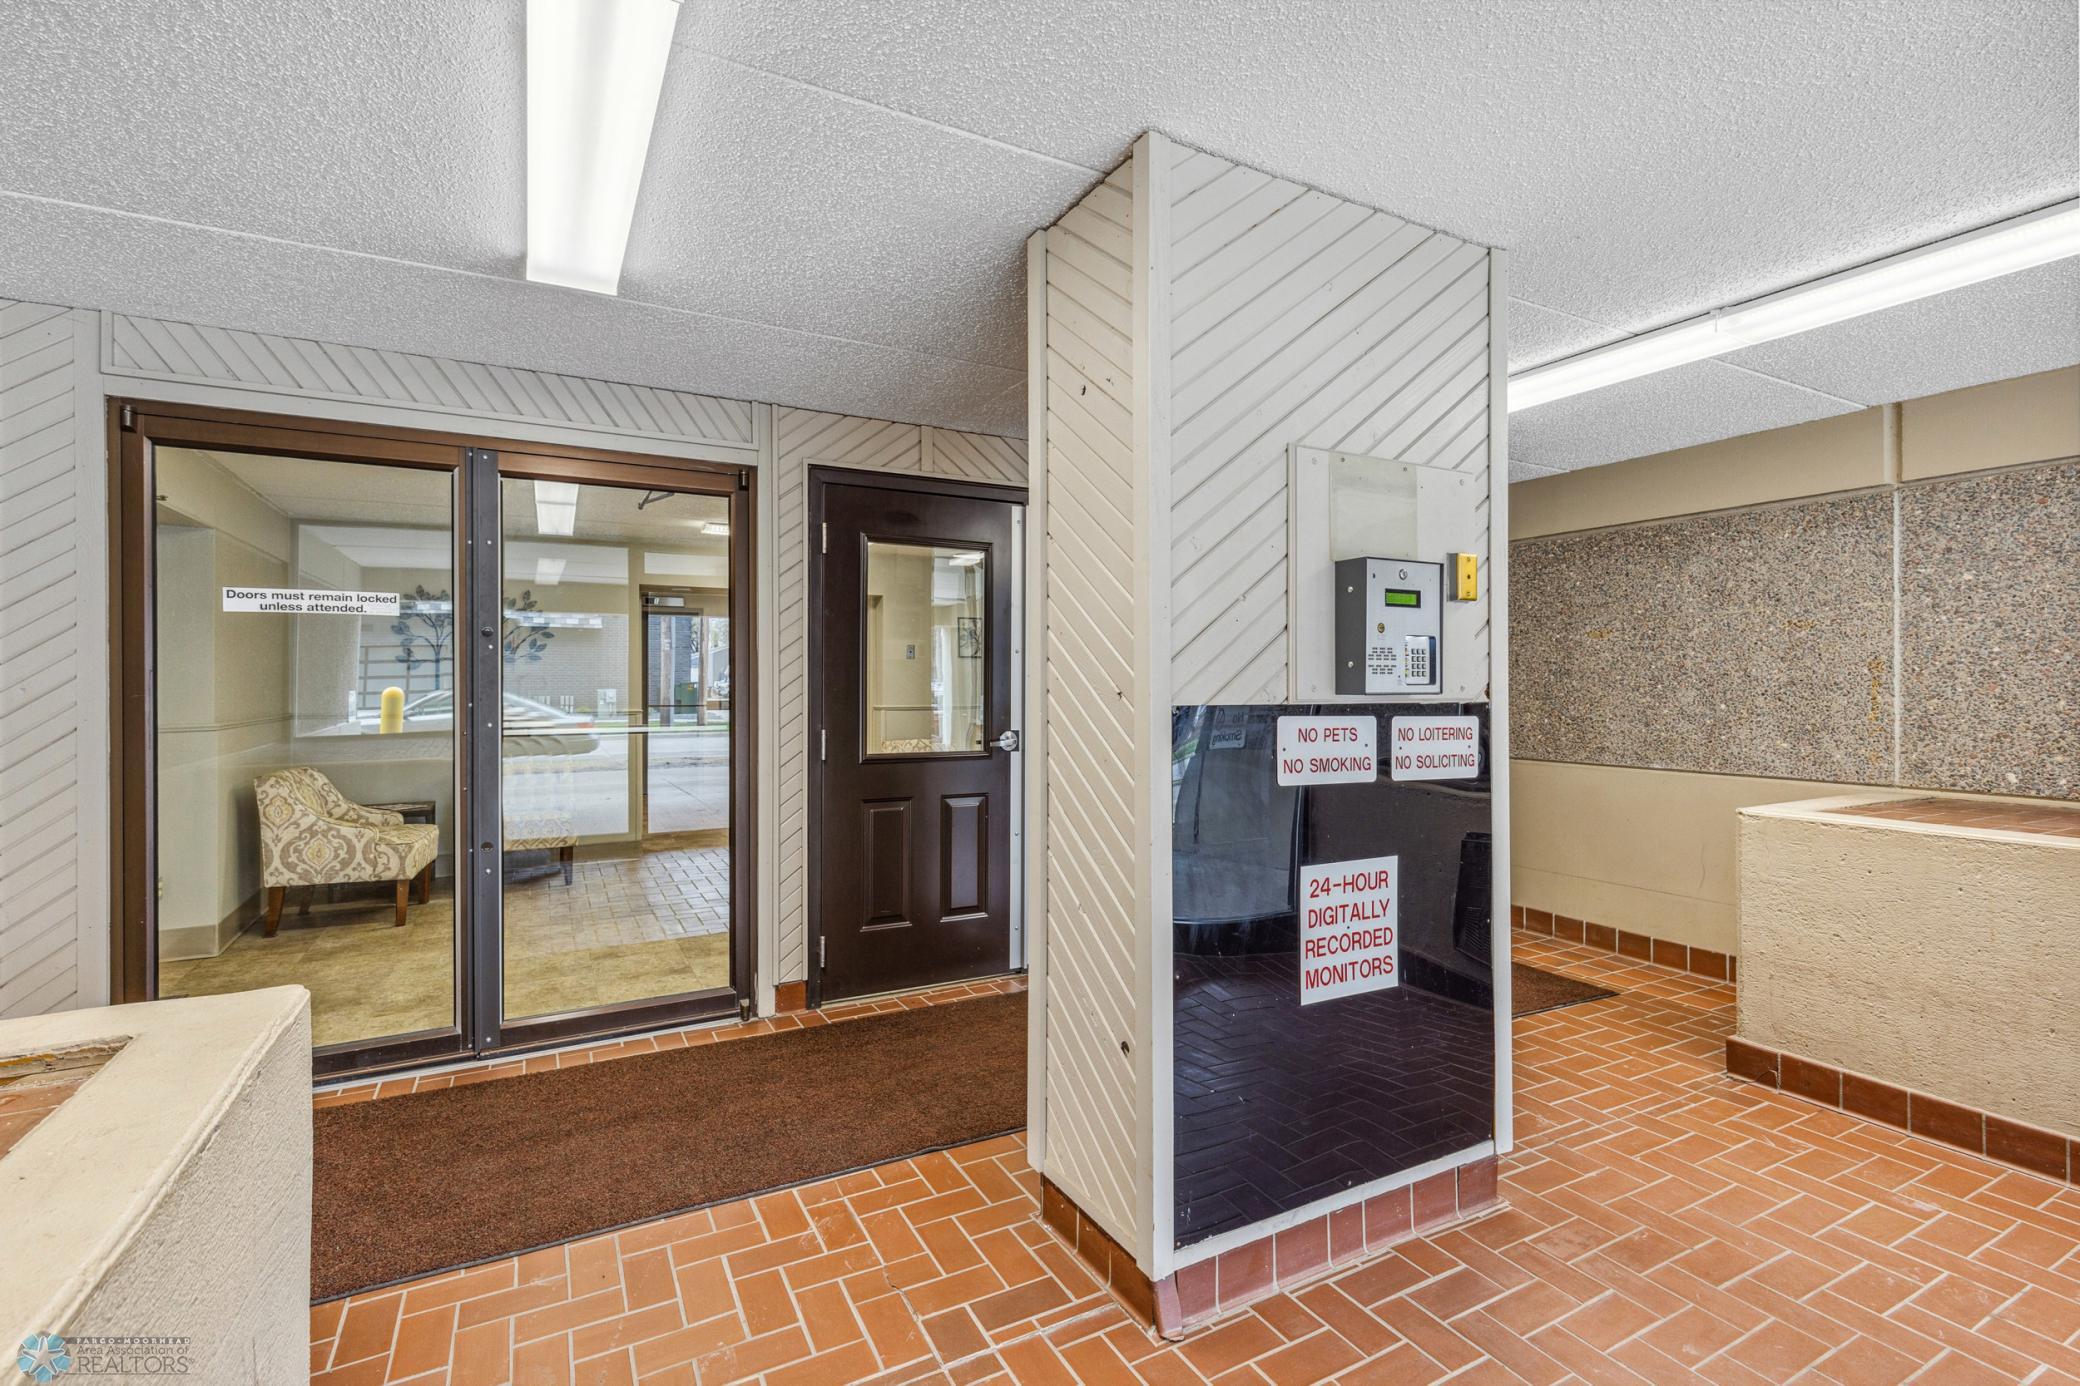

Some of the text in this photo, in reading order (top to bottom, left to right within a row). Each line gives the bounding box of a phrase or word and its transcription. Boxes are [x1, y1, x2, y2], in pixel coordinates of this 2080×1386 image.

[226, 589, 397, 604] Doors must remain locked
[259, 602, 367, 613] unless attended.
[1298, 727, 1358, 743] NO PETS
[1398, 726, 1473, 742] NO LOITERING
[1283, 756, 1372, 774] NO SMOKING
[1395, 753, 1475, 770] NO SOLICITING
[1309, 870, 1389, 899] 24-HOUR
[1308, 898, 1390, 929] DIGITALLY
[1305, 926, 1393, 960] RECORDED
[1305, 955, 1394, 990] MONITORS
